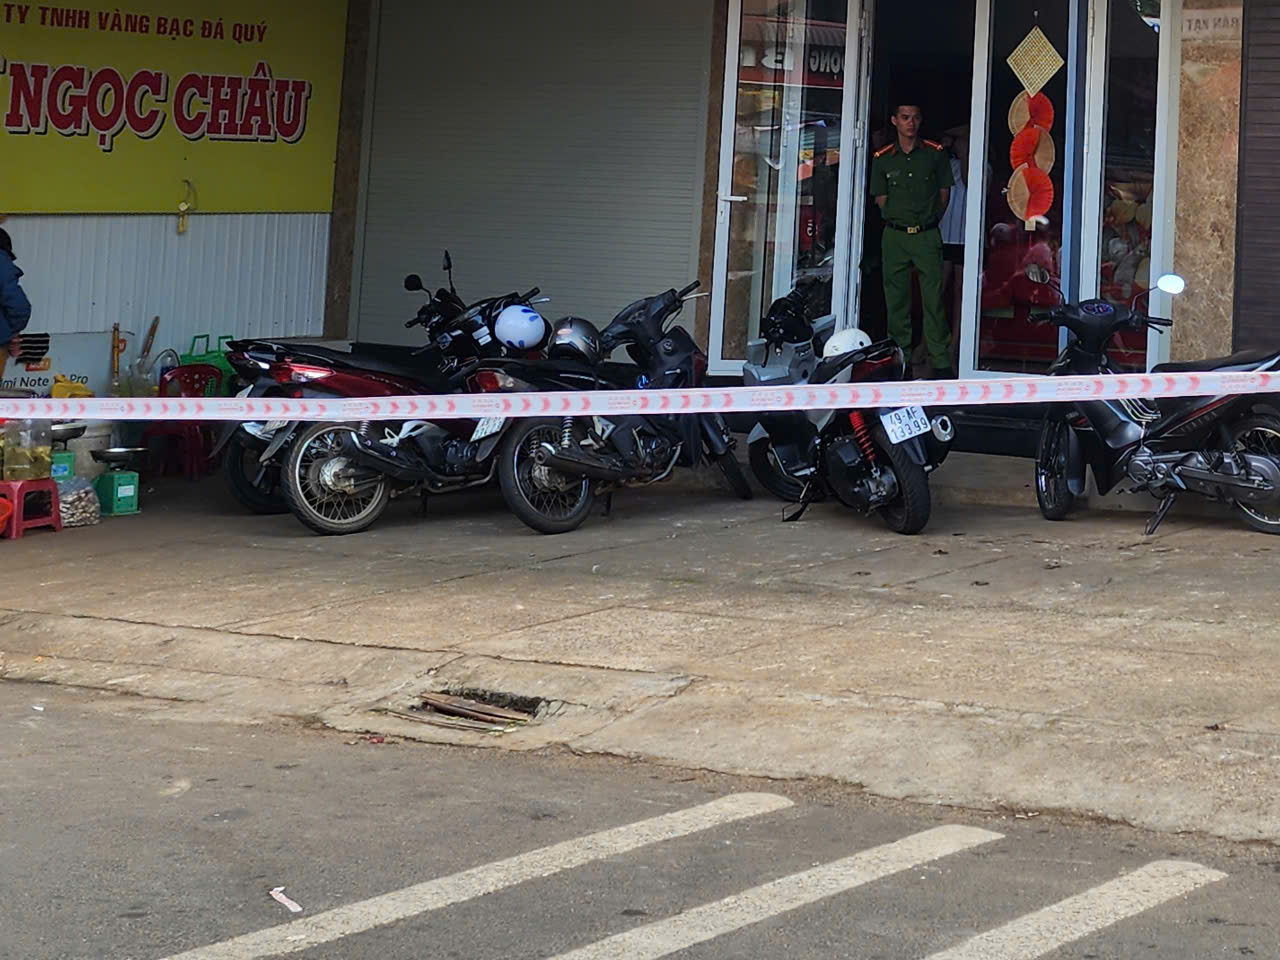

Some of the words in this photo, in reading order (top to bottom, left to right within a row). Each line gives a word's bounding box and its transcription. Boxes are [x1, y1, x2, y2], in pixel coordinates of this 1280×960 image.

[3, 3, 30, 25] TY
[38, 6, 90, 30] TNHH
[98, 8, 150, 35] VÀNG
[156, 16, 195, 40] BẠC
[200, 17, 225, 40] ĐÁ
[232, 21, 267, 44] QUÝ
[5, 62, 168, 152] NGỌC
[173, 61, 312, 144] CHÂU
[20, 376, 50, 388] Note
[70, 374, 89, 384] Pro
